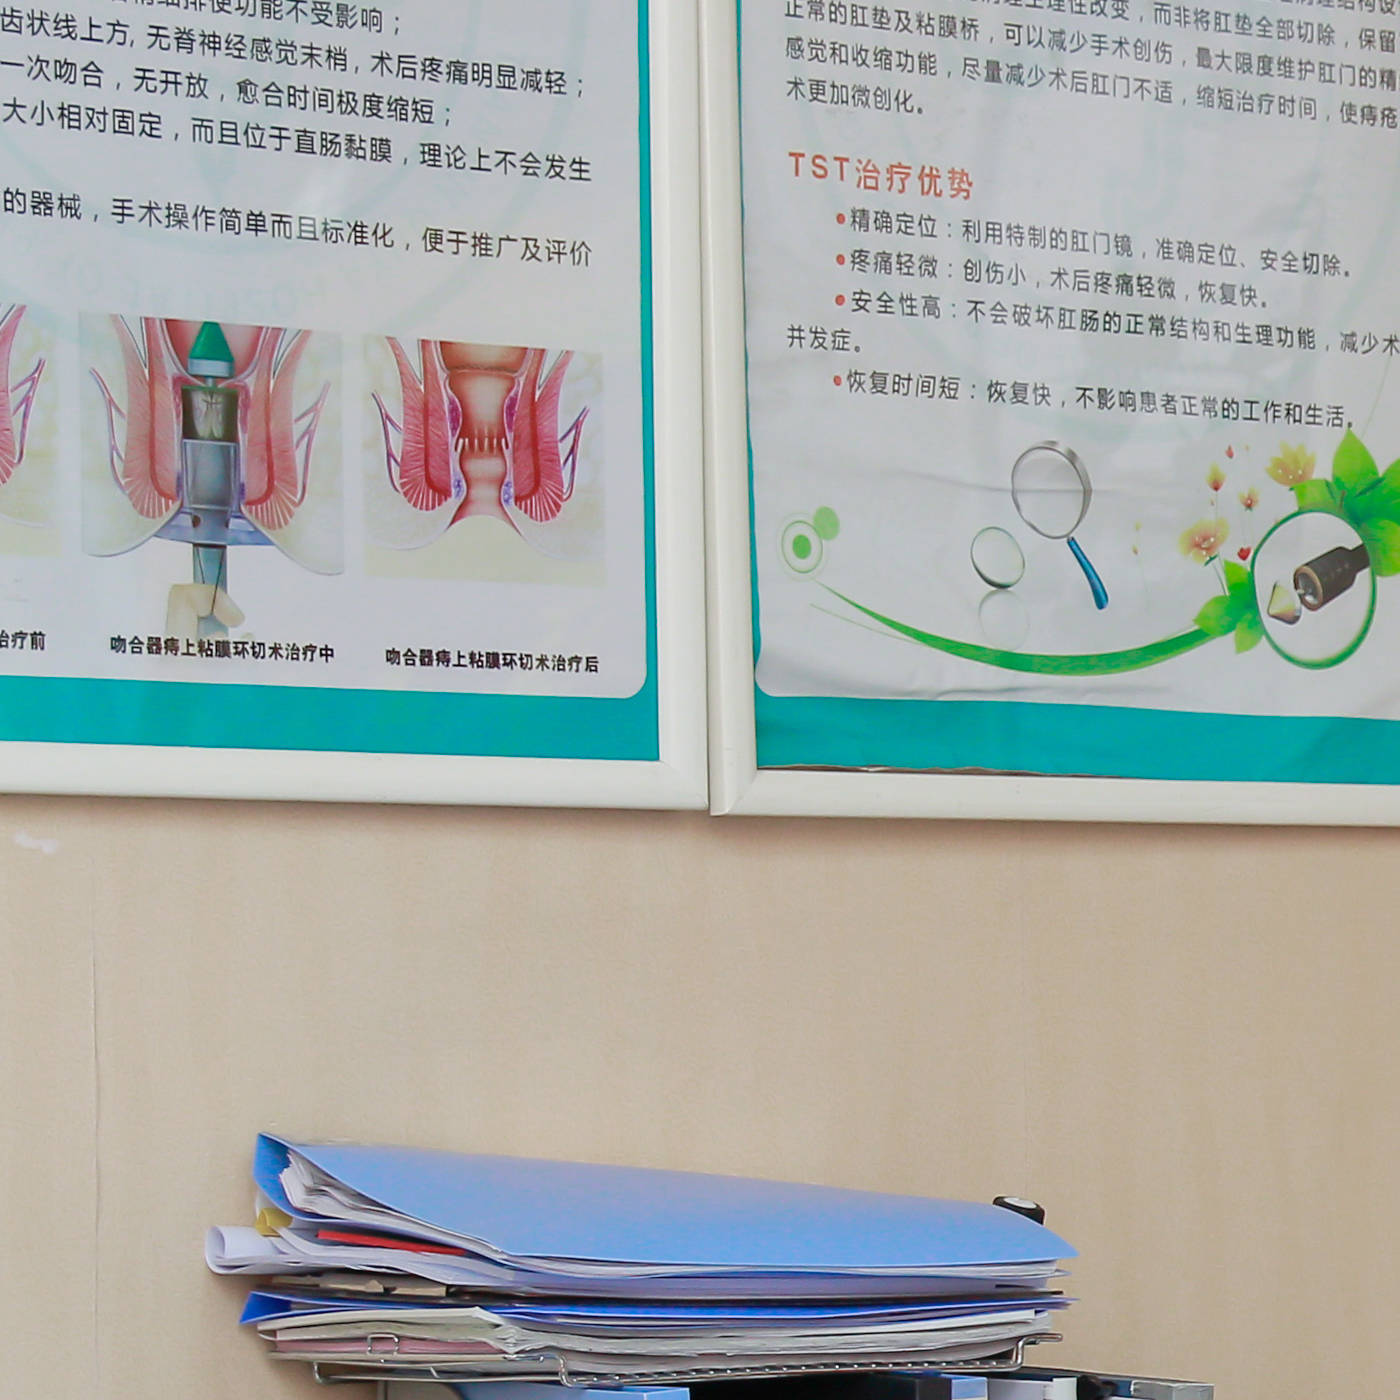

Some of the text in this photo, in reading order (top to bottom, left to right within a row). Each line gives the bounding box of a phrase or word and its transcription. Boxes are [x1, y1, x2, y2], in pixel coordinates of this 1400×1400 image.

[112, 0, 402, 37] 便功能不受影响；
[786, 77, 924, 115] 术更加微创化。
[788, 151, 974, 200] TST治疗优势
[786, 326, 862, 354] 并发症。
[110, 635, 335, 663] 吻合器痔上粘膜环切术治疗中
[385, 647, 600, 673] 吻合器痔上粘膜环切术治疗后
